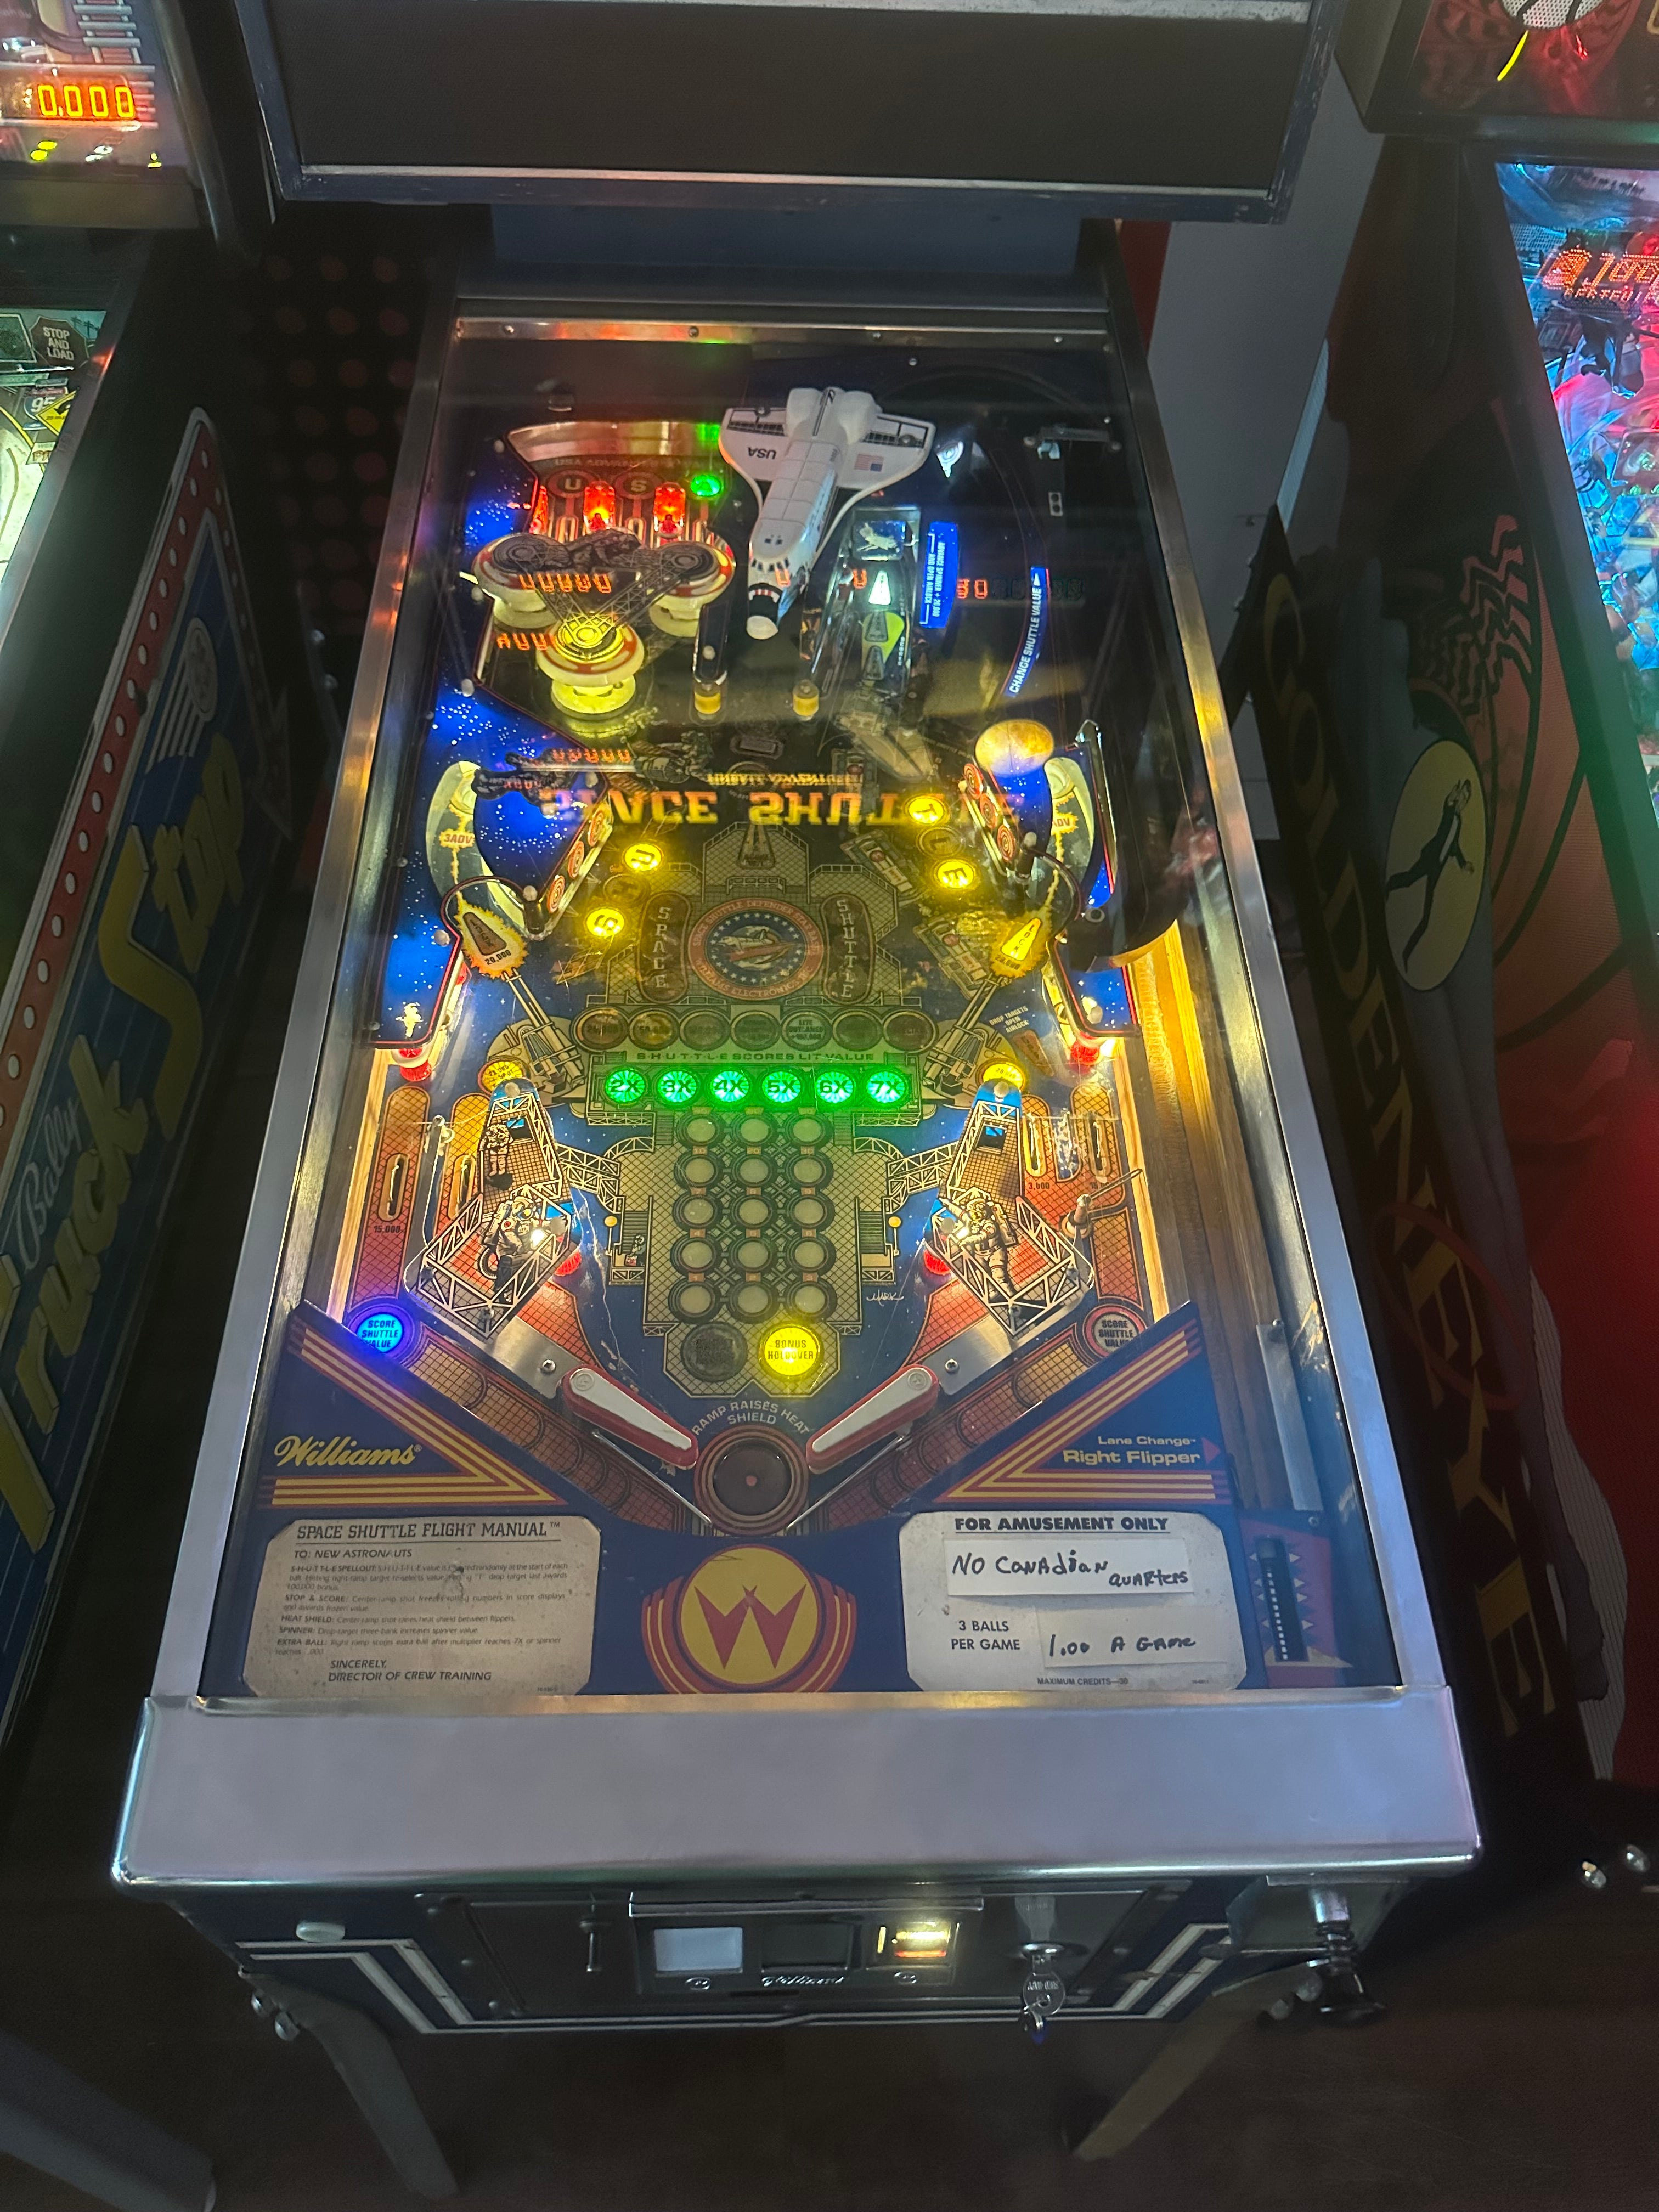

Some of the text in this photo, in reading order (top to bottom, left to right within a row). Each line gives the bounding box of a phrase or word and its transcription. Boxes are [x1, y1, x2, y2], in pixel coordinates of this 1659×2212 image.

[43, 326, 70, 340] STOP
[48, 338, 70, 349] AND
[47, 347, 75, 360] LOAD
[31, 397, 57, 412] 95
[747, 447, 777, 460] USA
[565, 477, 580, 490] U
[630, 476, 647, 492] S
[924, 553, 935, 604] AND OPEN AIRLOCK
[932, 542, 946, 617] ADVANCE SPINNER 20,000
[1008, 587, 1042, 694] CHANGE SHUTTLE VALUE
[915, 803, 937, 821] T
[631, 849, 656, 866] U
[943, 867, 968, 882] E
[594, 914, 619, 929] S
[693, 924, 709, 946] SPACE
[706, 902, 742, 924] SHUTTLE
[746, 900, 794, 915] DEFENDER
[98, 731, 245, 1142] Stop
[1013, 924, 1036, 952] LOCK
[653, 906, 672, 988] SPACE
[836, 899, 857, 998] SHUTTLE
[484, 949, 512, 966] 20,000
[696, 958, 799, 997] WILLIAMS ELECTRONICS
[989, 1006, 1029, 1026] DROP TARGETS
[1005, 1016, 1022, 1026] OPEN
[1005, 1019, 1030, 1034] AIRLOCK
[825, 1052, 874, 1060] VALUE
[611, 1078, 899, 1094] 2X 3X 4X 5X 6X 7X
[15, 1099, 83, 1271] Bally
[368, 1320, 396, 1328] SCORE
[1101, 1319, 1128, 1328] SCORE
[362, 1330, 399, 1338] SHUTTLE
[1098, 1329, 1134, 1338] SHUTTLE
[775, 1340, 806, 1348] BONUS
[768, 1351, 814, 1360] HOLDOVER
[691, 1400, 810, 1436] RAMP RAISES HEAT
[727, 1411, 777, 1425] SHIELD
[1098, 1436, 1133, 1446] Lane
[1063, 1449, 1200, 1466] Right Flipper
[297, 1525, 343, 1539] SPACE
[348, 1523, 417, 1539] SHUTTLE
[422, 1523, 476, 1538] FLIGHT
[955, 1517, 1169, 1531] FOR AMUSEMENT ONLY
[294, 1550, 311, 1559] TO:
[314, 1550, 340, 1559] NEW
[952, 1552, 985, 1576] NO
[507, 1573, 527, 1581] target
[538, 1593, 565, 1601] displays
[958, 1620, 1009, 1632] 3 BALLS
[951, 1639, 1020, 1650] PER GAME
[1110, 1636, 1126, 1653] A
[330, 1660, 387, 1669] SINCERELY,
[329, 1671, 492, 1681] DIRECTOR OF CREW TRAINING
[1037, 1677, 1076, 1686] MAXIMUM
